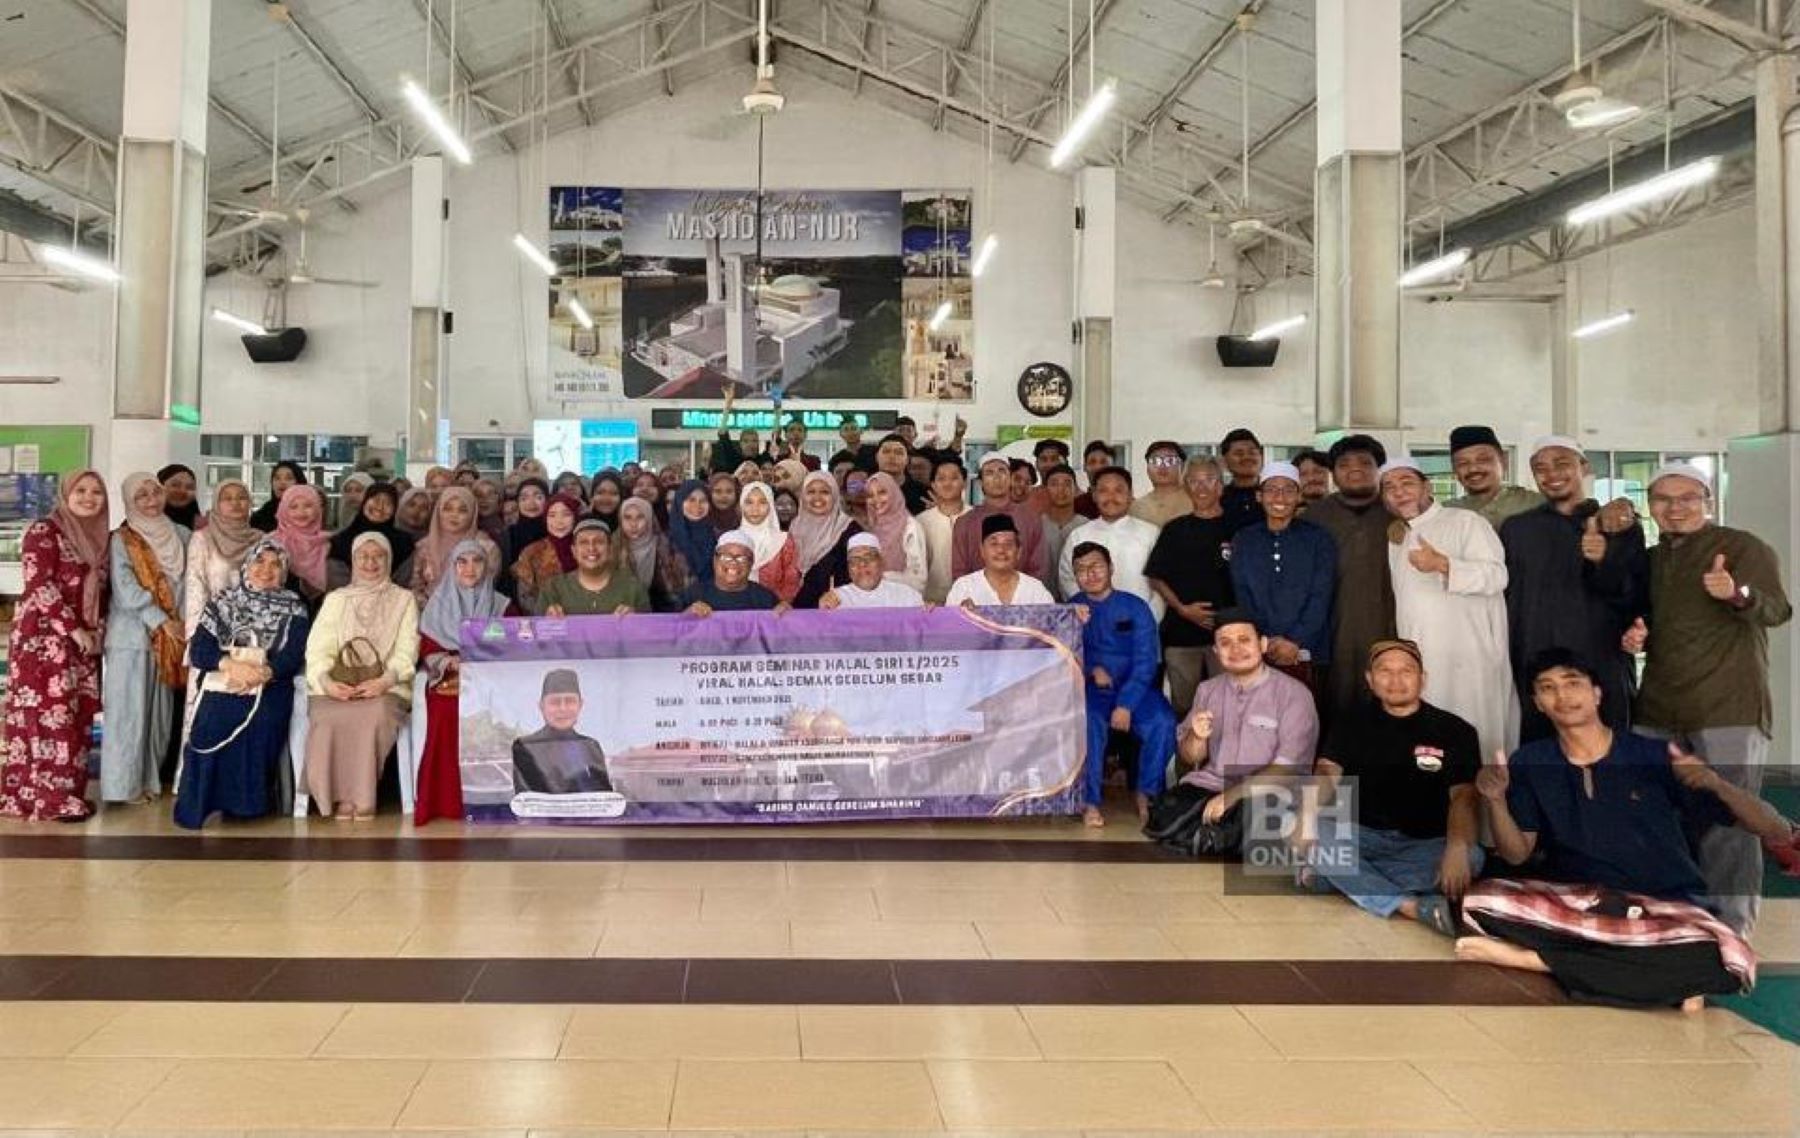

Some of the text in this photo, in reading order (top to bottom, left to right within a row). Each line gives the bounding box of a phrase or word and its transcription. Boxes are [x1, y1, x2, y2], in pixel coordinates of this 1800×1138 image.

[666, 211, 859, 241] MASJID AN-NUR
[681, 655, 960, 675] PROGRAM SEMINAR HALAL SIRI 1/2025
[697, 672, 943, 689] VIRAL HALAL: SEMAK SEBELUM SEBAR
